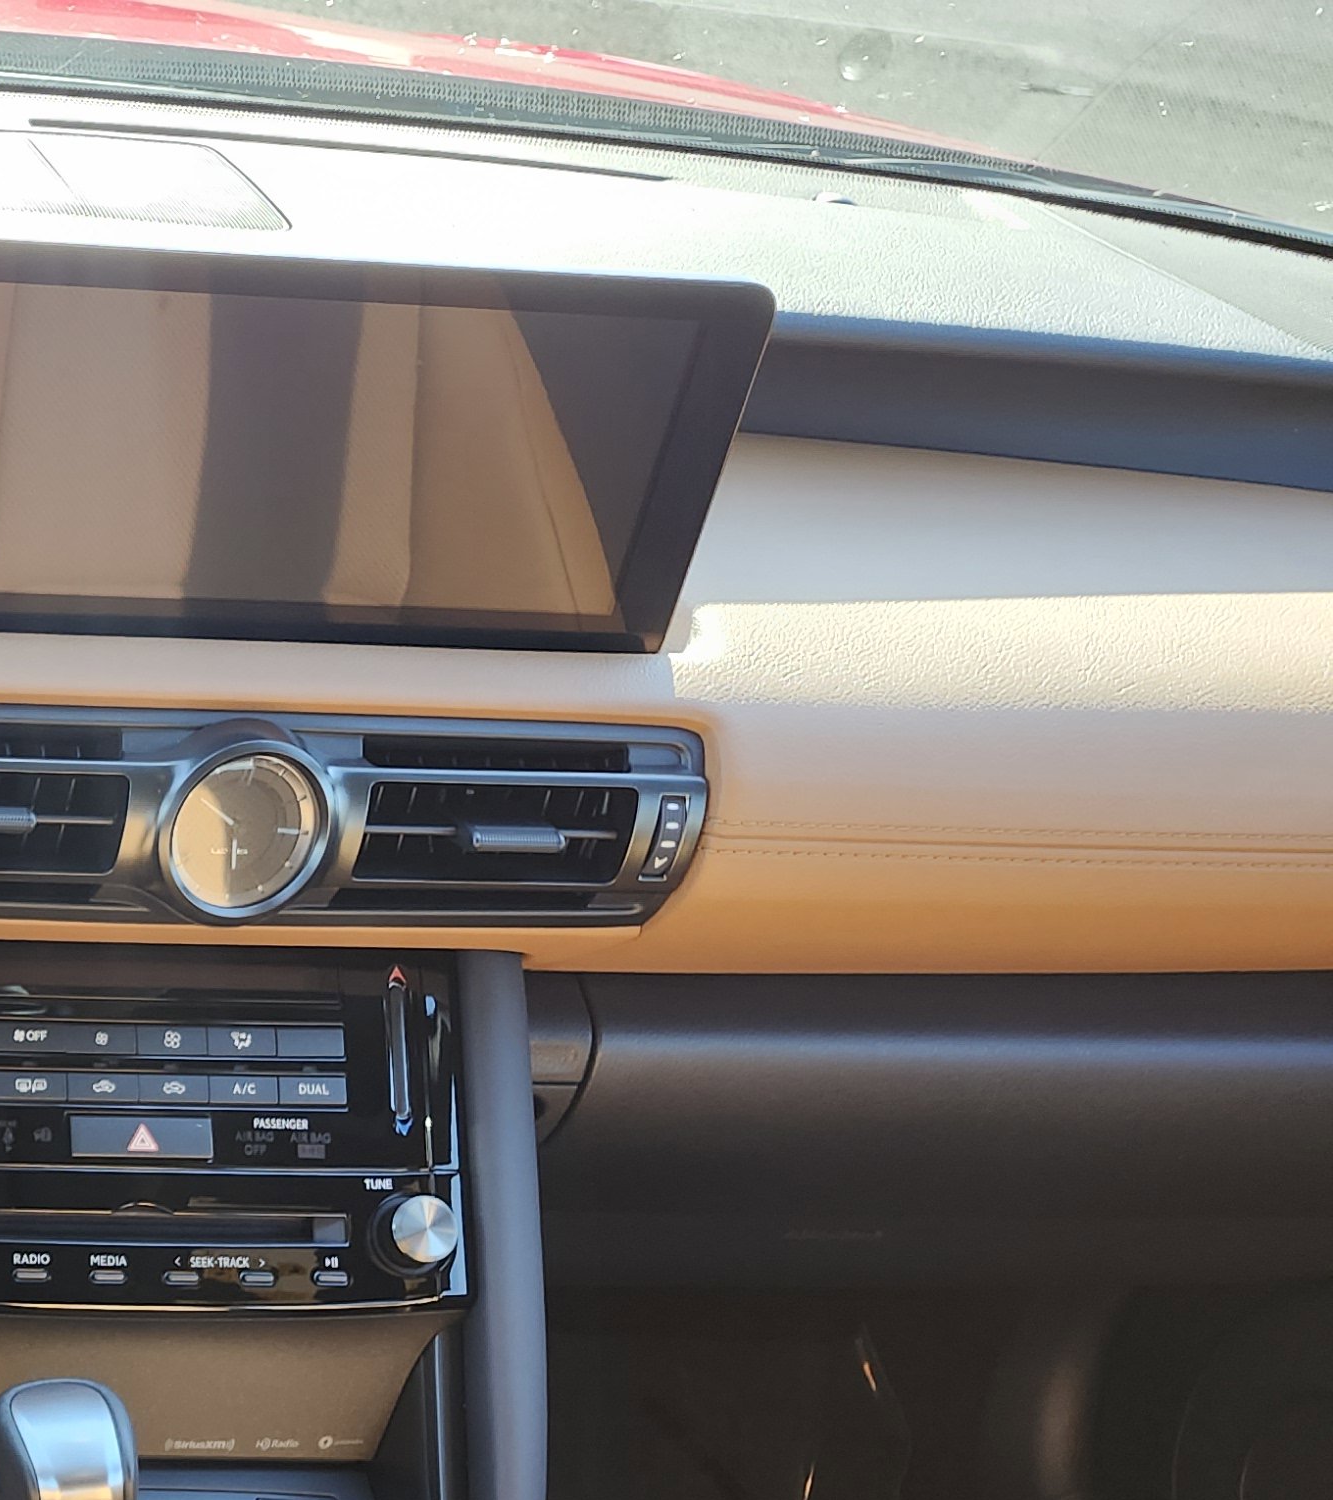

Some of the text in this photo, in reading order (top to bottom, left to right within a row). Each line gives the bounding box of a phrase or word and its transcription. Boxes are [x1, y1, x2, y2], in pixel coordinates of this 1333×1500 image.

[26, 1030, 48, 1042] OFF
[232, 1083, 257, 1095] A/C
[298, 1083, 330, 1096] DUAL
[253, 1117, 309, 1131] PASSENGER
[235, 1131, 253, 1142] AIR
[290, 1131, 308, 1143] AIR
[363, 1178, 393, 1190] TUNE
[13, 1253, 51, 1265] RADIO
[90, 1254, 128, 1267] MEDIA
